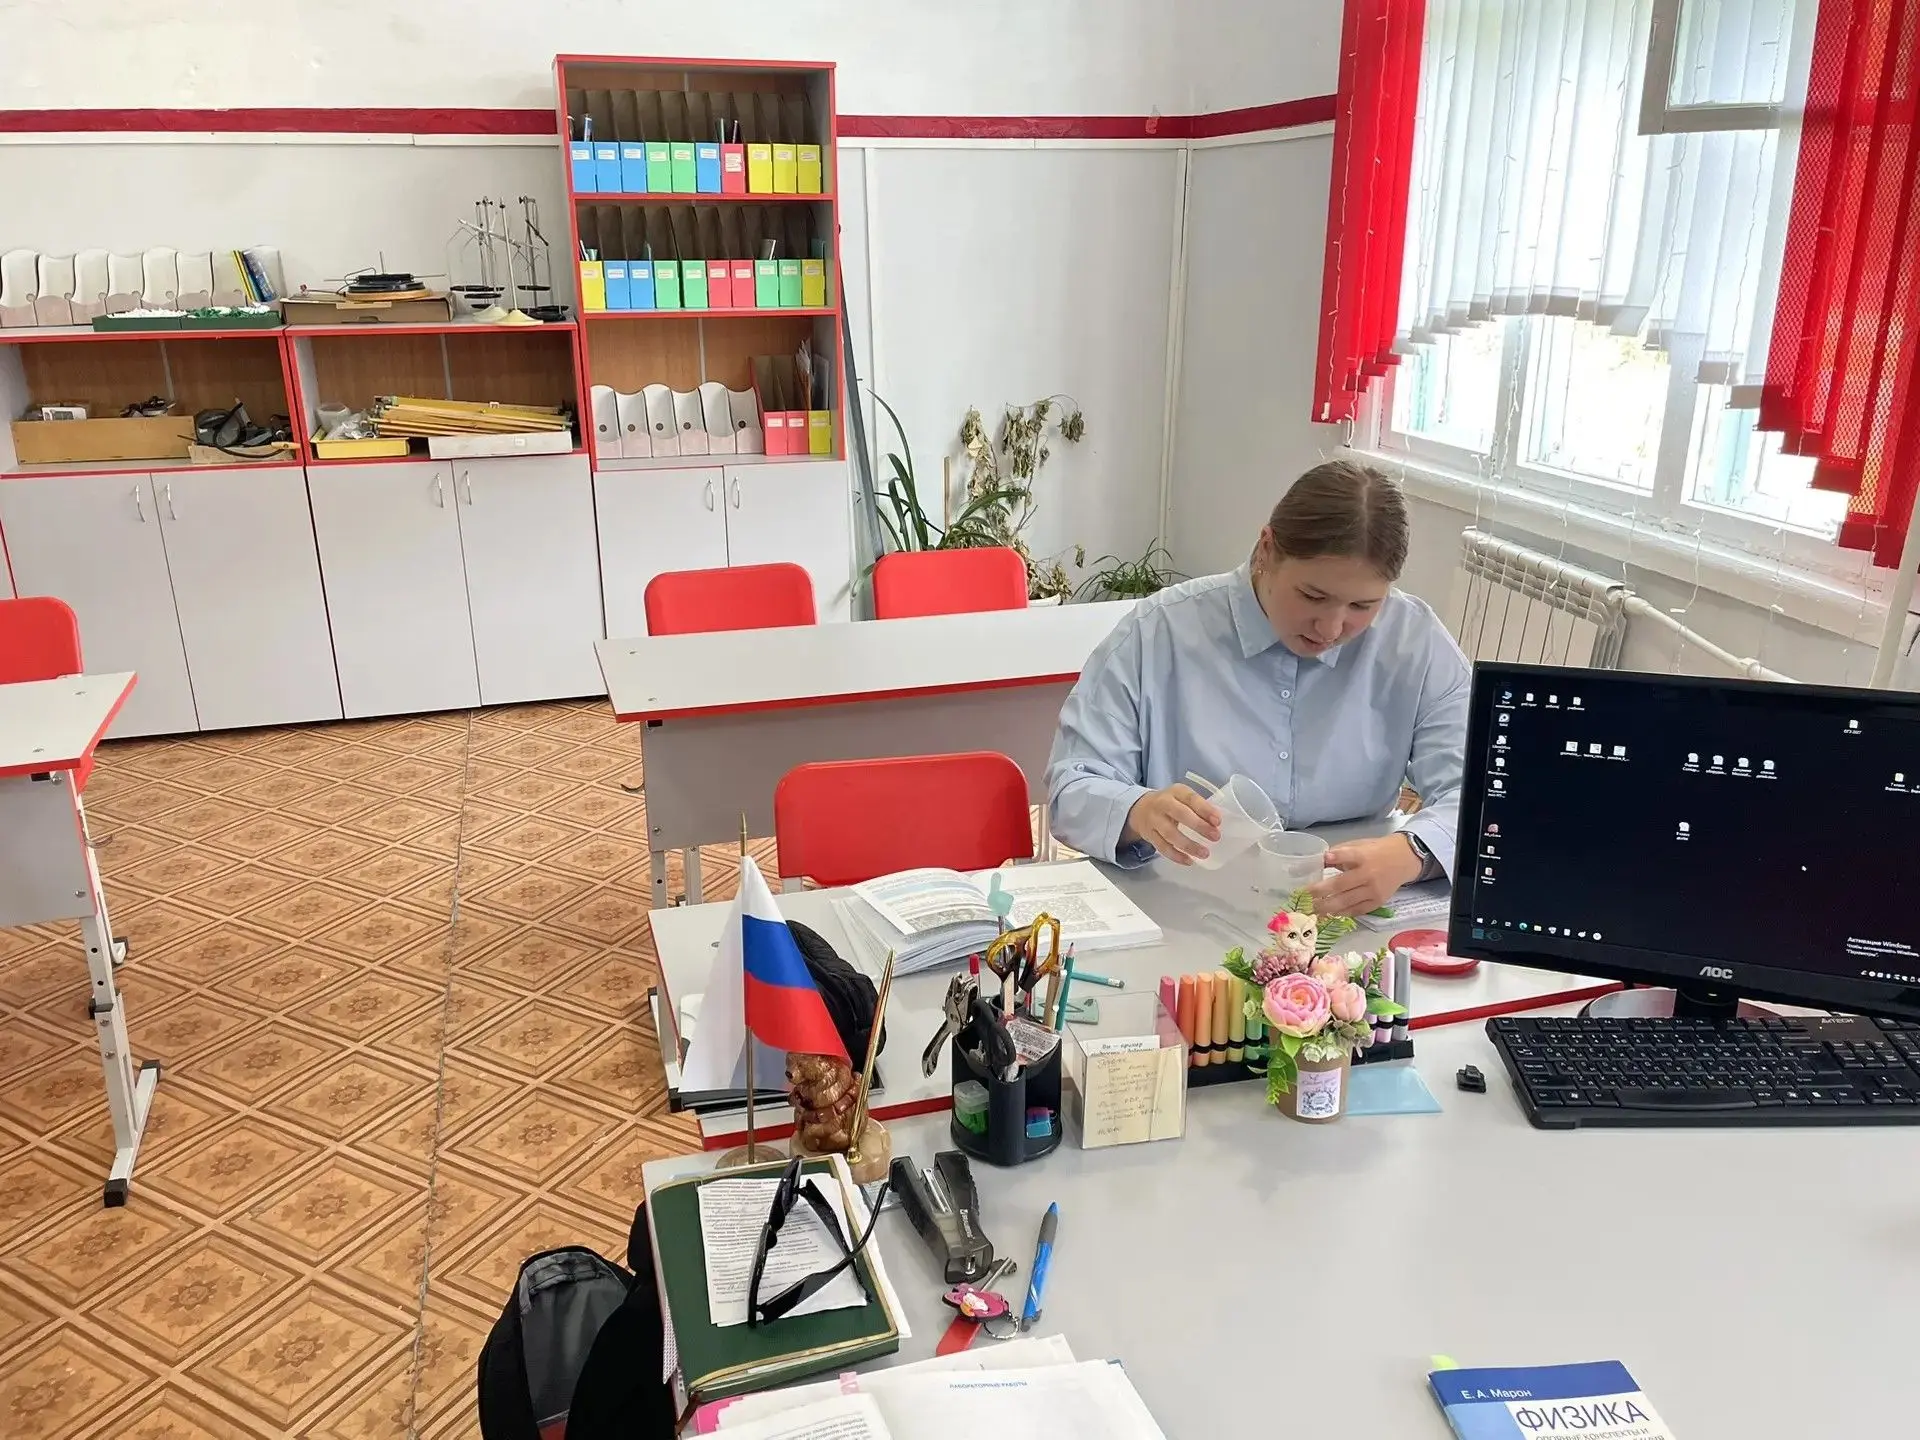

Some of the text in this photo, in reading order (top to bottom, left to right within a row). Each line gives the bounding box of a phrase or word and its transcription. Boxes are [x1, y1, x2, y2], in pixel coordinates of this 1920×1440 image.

[1882, 941, 1912, 950] Windows
[1699, 966, 1733, 979] AOC
[1461, 1388, 1533, 1399] Е. А. Марон
[1516, 1400, 1650, 1431] ФИЗИКА
